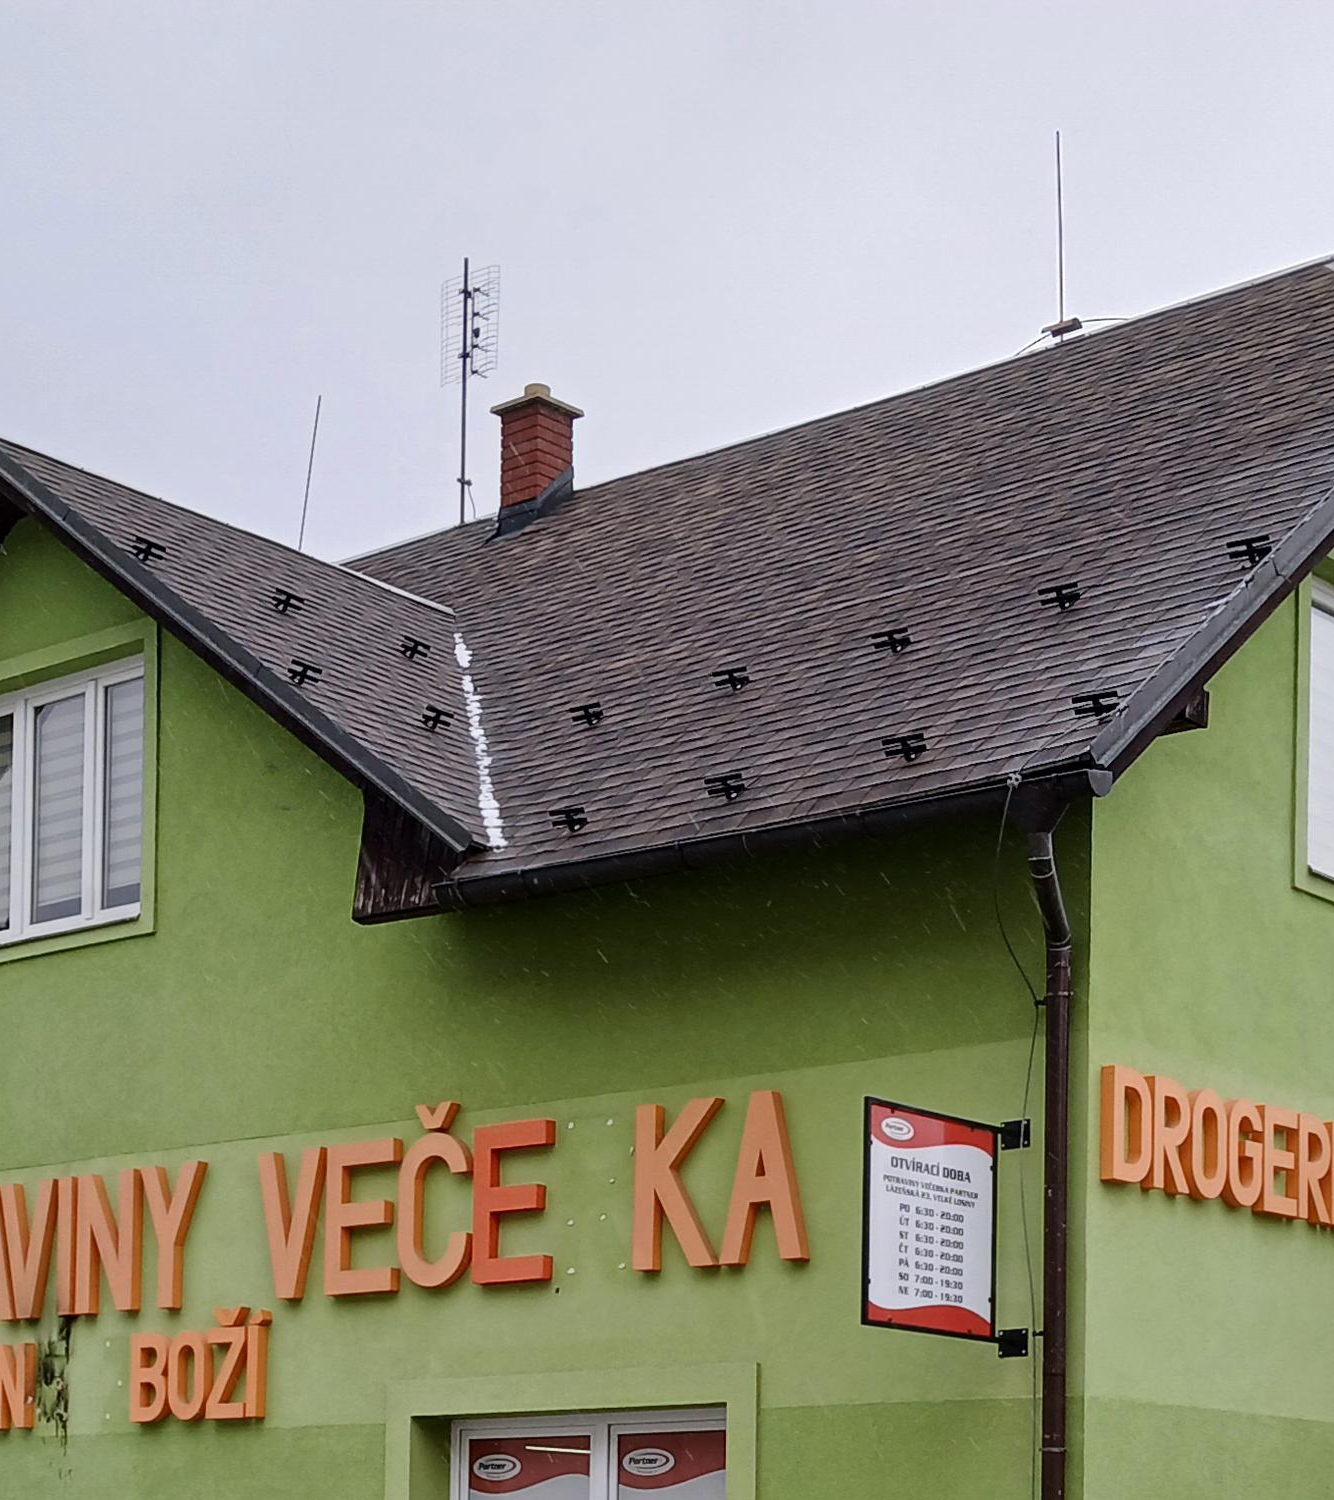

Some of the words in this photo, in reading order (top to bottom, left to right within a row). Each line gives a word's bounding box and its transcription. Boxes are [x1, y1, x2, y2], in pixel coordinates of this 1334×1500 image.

[890, 1156, 940, 1177] OTVÍRACÍ
[942, 1167, 971, 1184] DOBA
[259, 1101, 556, 1300] VEČE
[632, 1090, 810, 1271] KA
[915, 1206, 934, 1217] 6:30
[940, 1211, 964, 1223] 20:00
[915, 1220, 934, 1231] 6:30
[940, 1225, 964, 1236] 20:00
[915, 1234, 934, 1244] 6:30
[940, 1238, 964, 1250] 20:00
[915, 1247, 934, 1258] 6:30
[940, 1252, 963, 1263] 20:00
[915, 1261, 934, 1271] 6:30
[940, 1265, 963, 1277] 20:00
[914, 1274, 933, 1285] 7:00
[941, 1279, 963, 1290] 19:30
[914, 1288, 933, 1299] 7:00
[941, 1293, 963, 1304] 19:30
[129, 1306, 273, 1423] BOŽÍ
[477, 1462, 507, 1471] Partner
[628, 1456, 659, 1465] Partner
